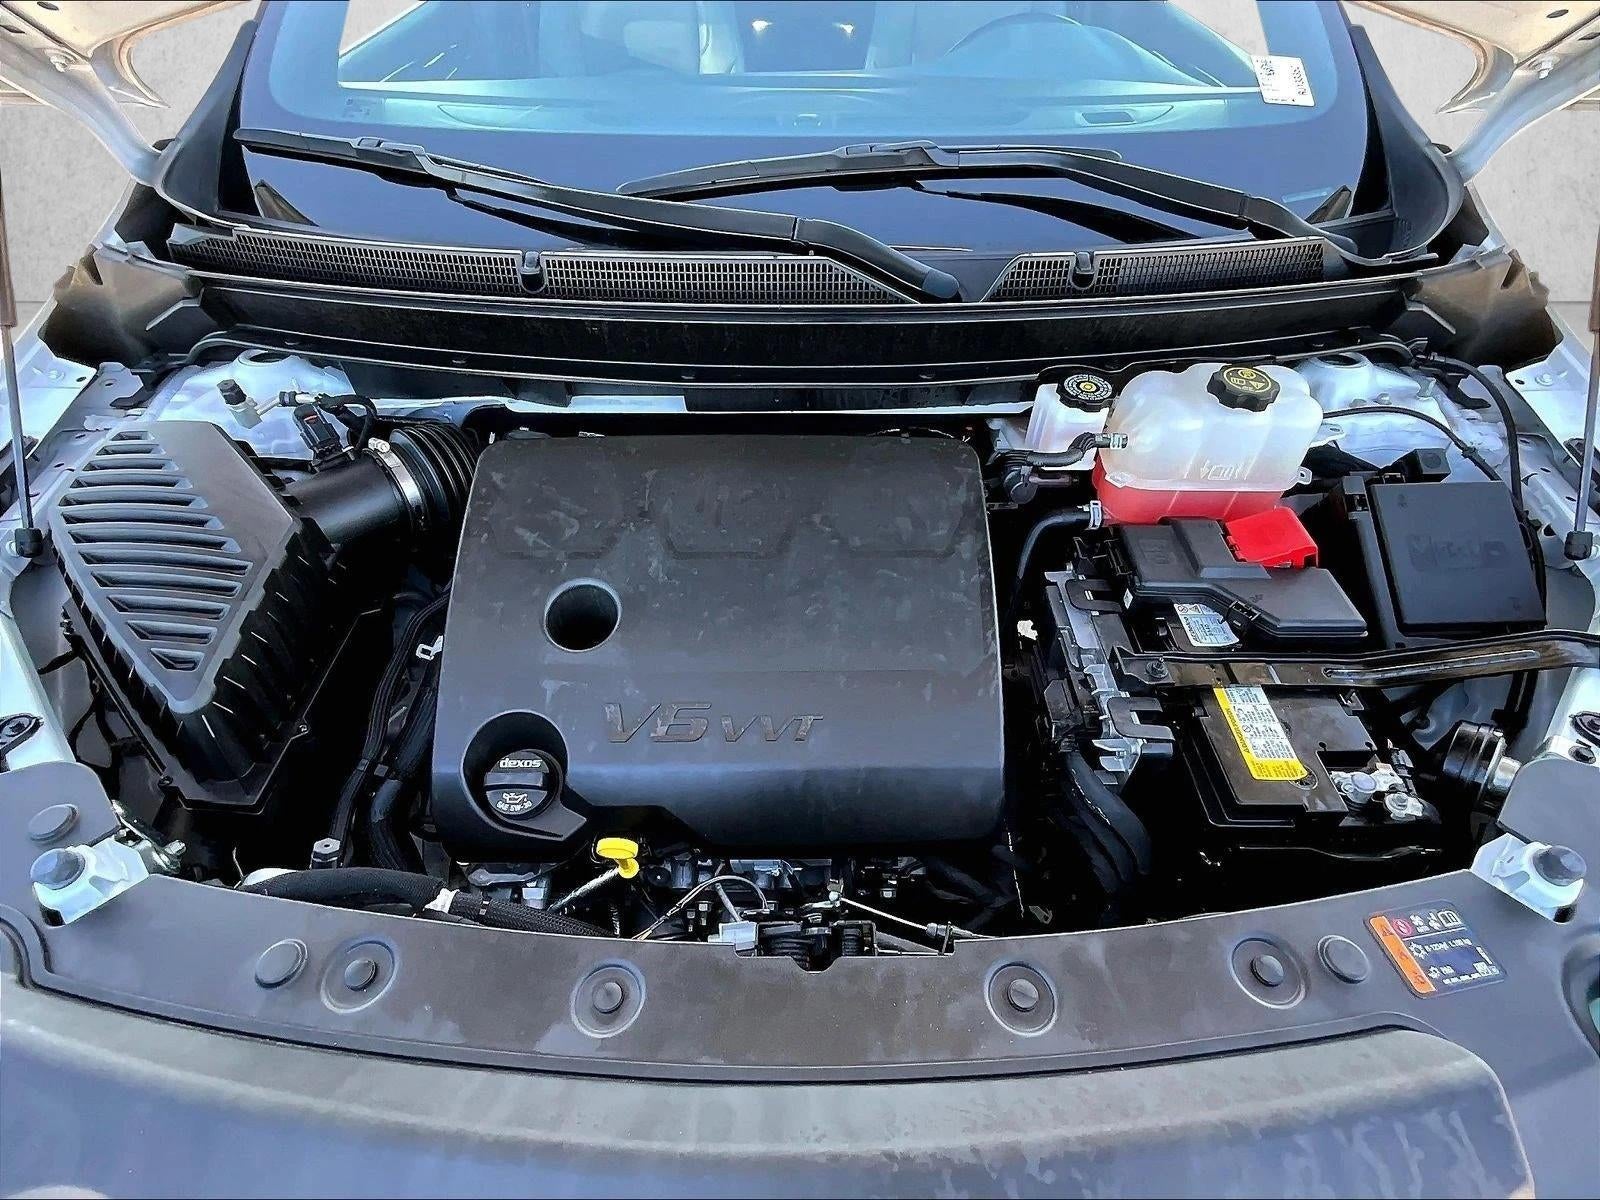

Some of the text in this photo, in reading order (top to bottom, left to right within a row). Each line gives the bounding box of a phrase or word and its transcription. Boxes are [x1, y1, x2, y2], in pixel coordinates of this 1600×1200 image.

[604, 703, 824, 743] V6 VVT
[499, 757, 543, 768] dexos
